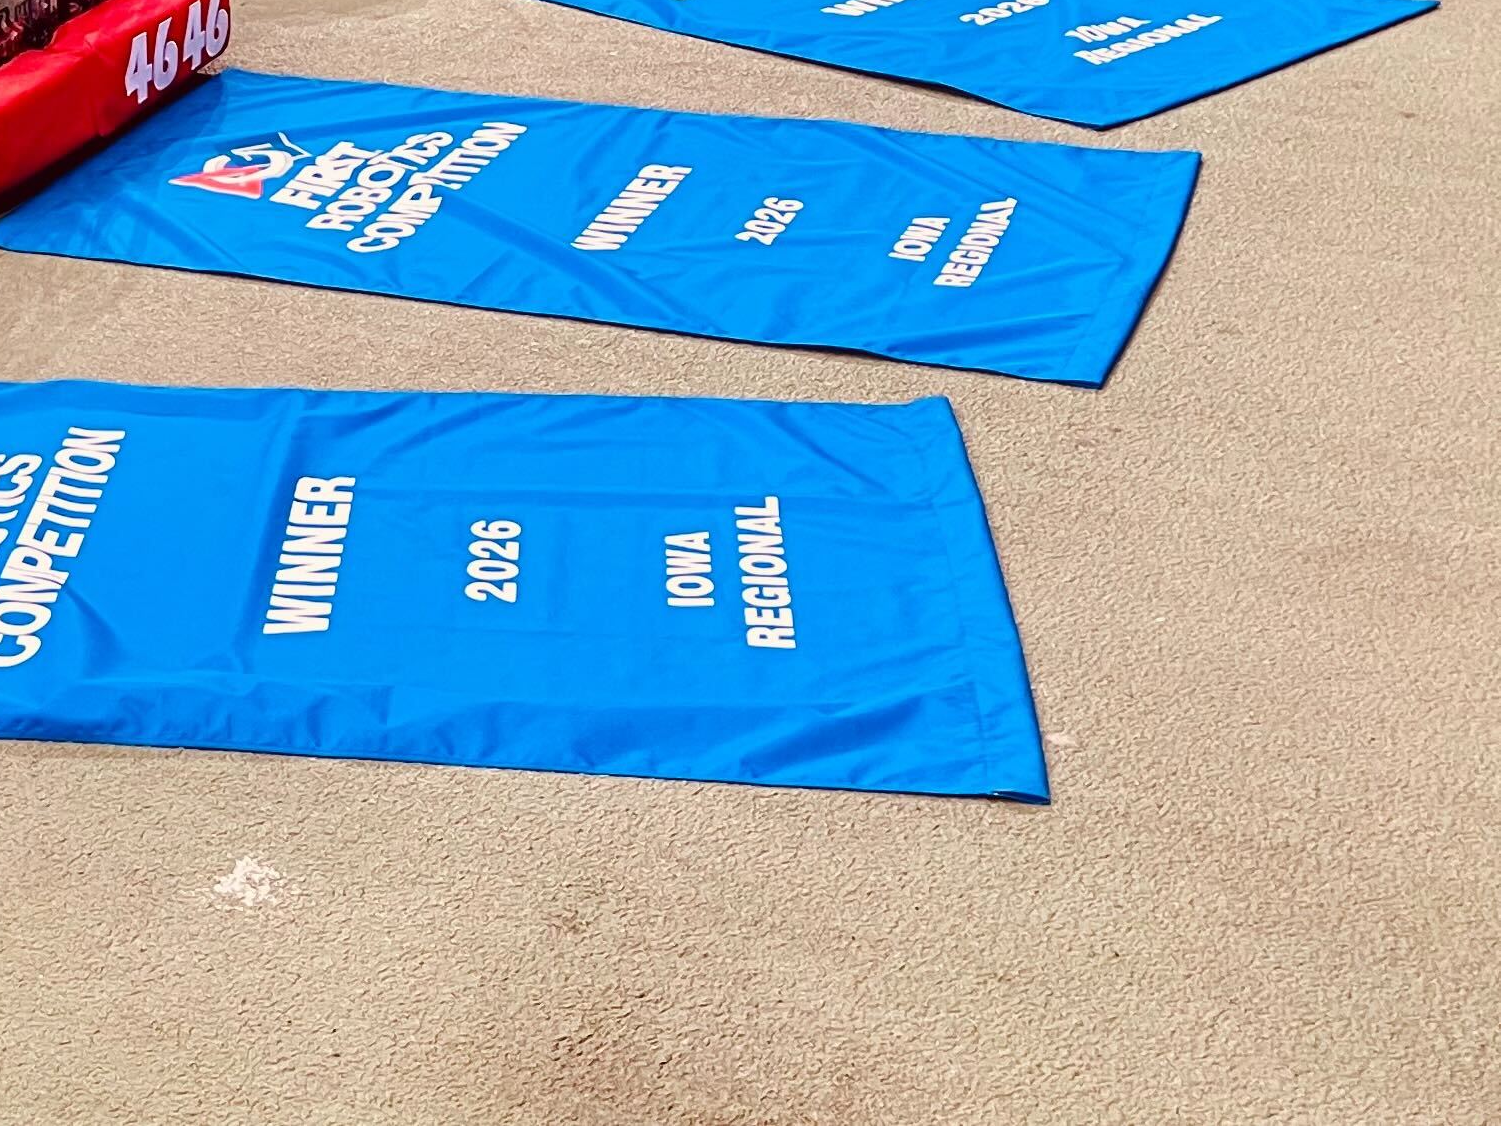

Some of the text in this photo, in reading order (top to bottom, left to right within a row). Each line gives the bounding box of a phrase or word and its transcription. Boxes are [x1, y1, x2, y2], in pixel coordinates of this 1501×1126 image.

[1065, 16, 1151, 43] IOWA
[1074, 13, 1222, 65] REGIONAL
[305, 130, 454, 232] ROBOTICS
[346, 122, 528, 253] COMPTITION
[572, 164, 693, 251] WINNER
[735, 197, 804, 246] 2026
[888, 216, 951, 262] IOWA
[933, 197, 1017, 288] REGIONAL
[263, 476, 356, 635] WINNER
[465, 520, 522, 603] 2026
[666, 531, 715, 607] IOWA
[735, 496, 797, 650] REGIONAL
